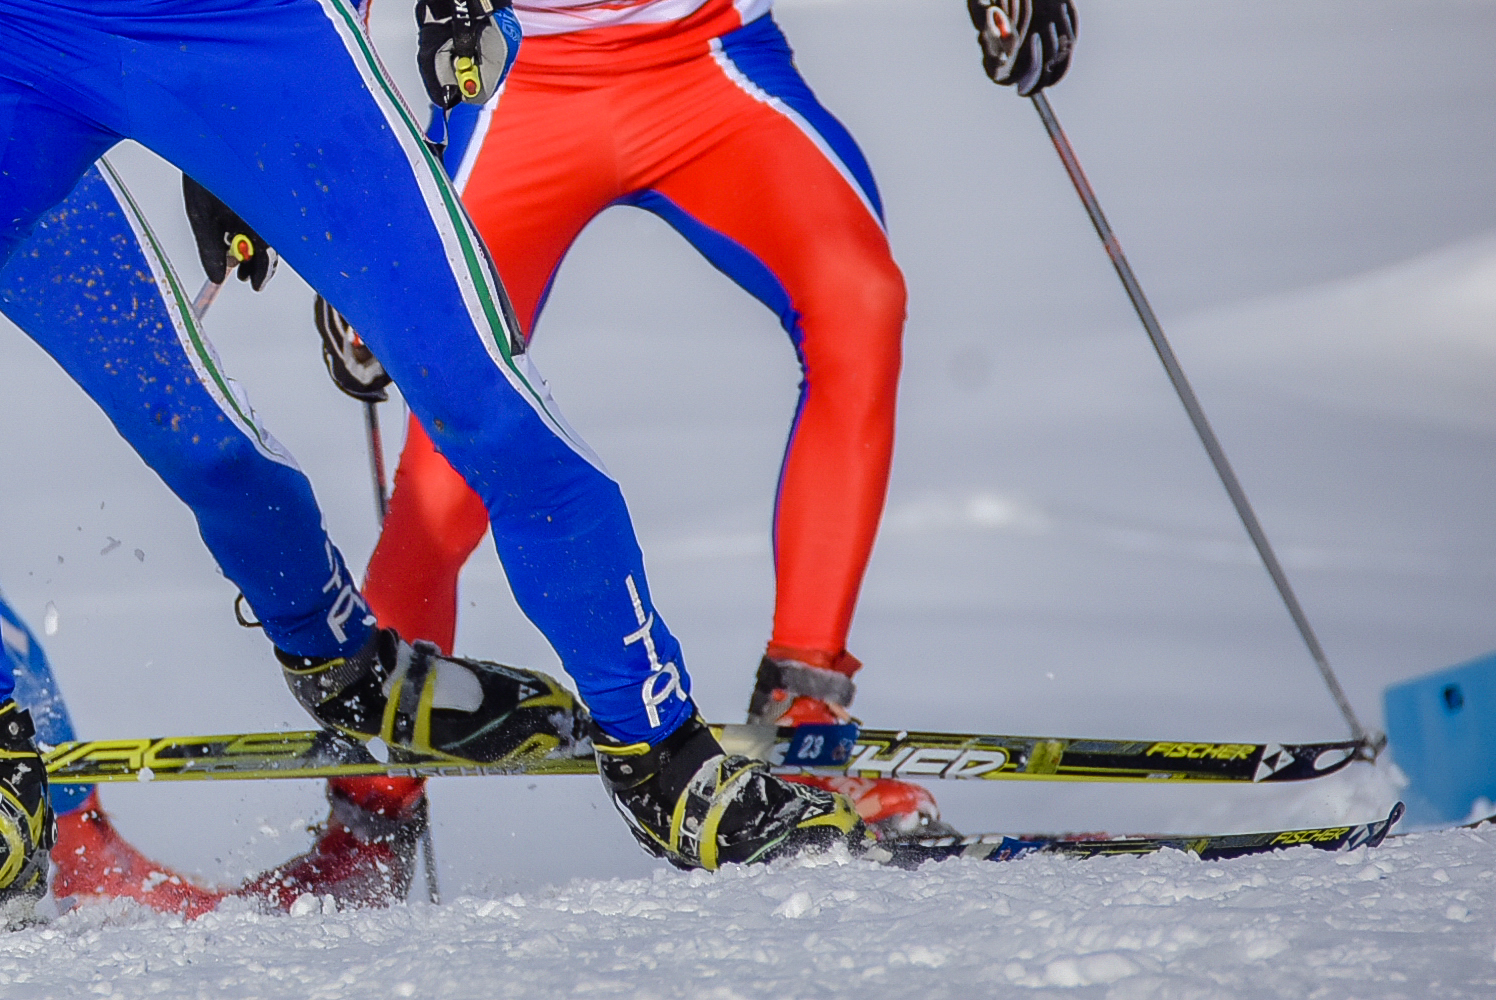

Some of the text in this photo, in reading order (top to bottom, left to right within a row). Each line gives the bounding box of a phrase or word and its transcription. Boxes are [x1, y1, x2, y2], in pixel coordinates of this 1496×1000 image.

[797, 734, 825, 759] 23
[1146, 741, 1256, 761] FISCHER
[1270, 827, 1350, 846] FISCHER
